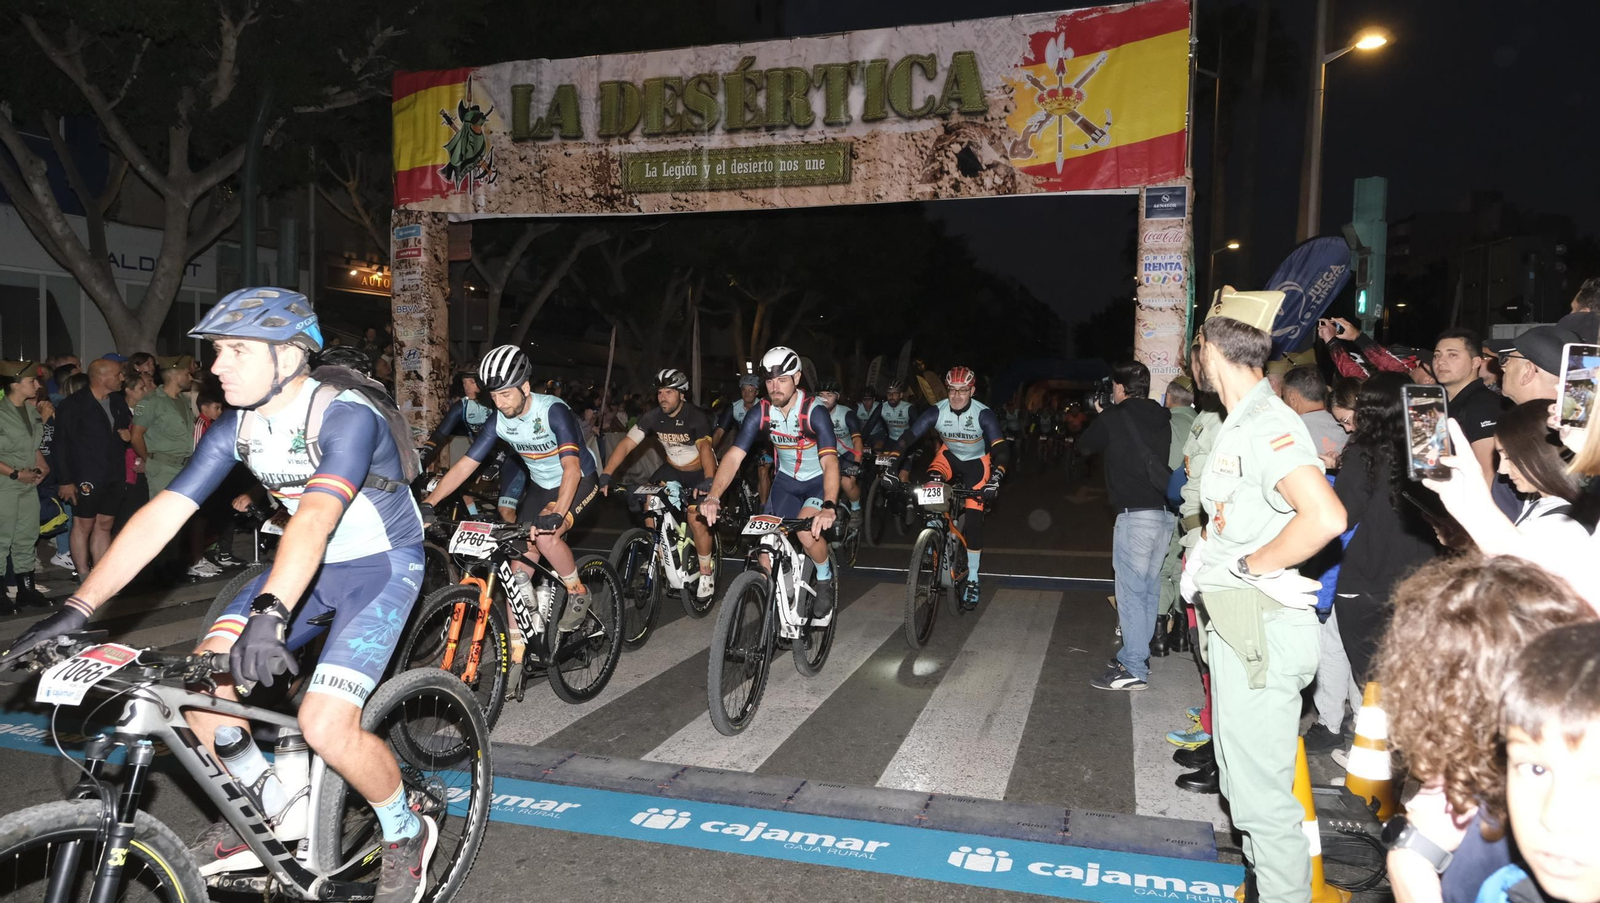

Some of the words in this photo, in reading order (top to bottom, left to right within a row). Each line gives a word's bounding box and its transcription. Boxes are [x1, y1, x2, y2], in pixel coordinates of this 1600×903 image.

[511, 83, 584, 141] LA
[598, 50, 989, 138] DESÉRTICA
[644, 162, 658, 178] La
[662, 160, 698, 180] Legión
[703, 164, 710, 180] y
[716, 161, 726, 175] el
[731, 158, 774, 175] desierto
[779, 159, 799, 173] nos
[805, 157, 825, 171] une
[1144, 262, 1183, 272] RENTA
[361, 275, 390, 288] AUTO
[1308, 265, 1342, 302] JUEGA
[1150, 365, 1180, 374] imaflor
[922, 487, 942, 498] 7238
[749, 520, 776, 531] 8339
[457, 531, 486, 547] 8760
[500, 560, 538, 637] GHOST
[53, 658, 113, 684] 7066
[312, 673, 325, 685] LA
[518, 808, 561, 819] RURAL
[700, 821, 891, 854] cajamar
[783, 843, 822, 853] CAJA
[826, 848, 877, 860] RURAL
[1027, 861, 1240, 900] cajamar
[1134, 888, 1178, 899] CAJA
